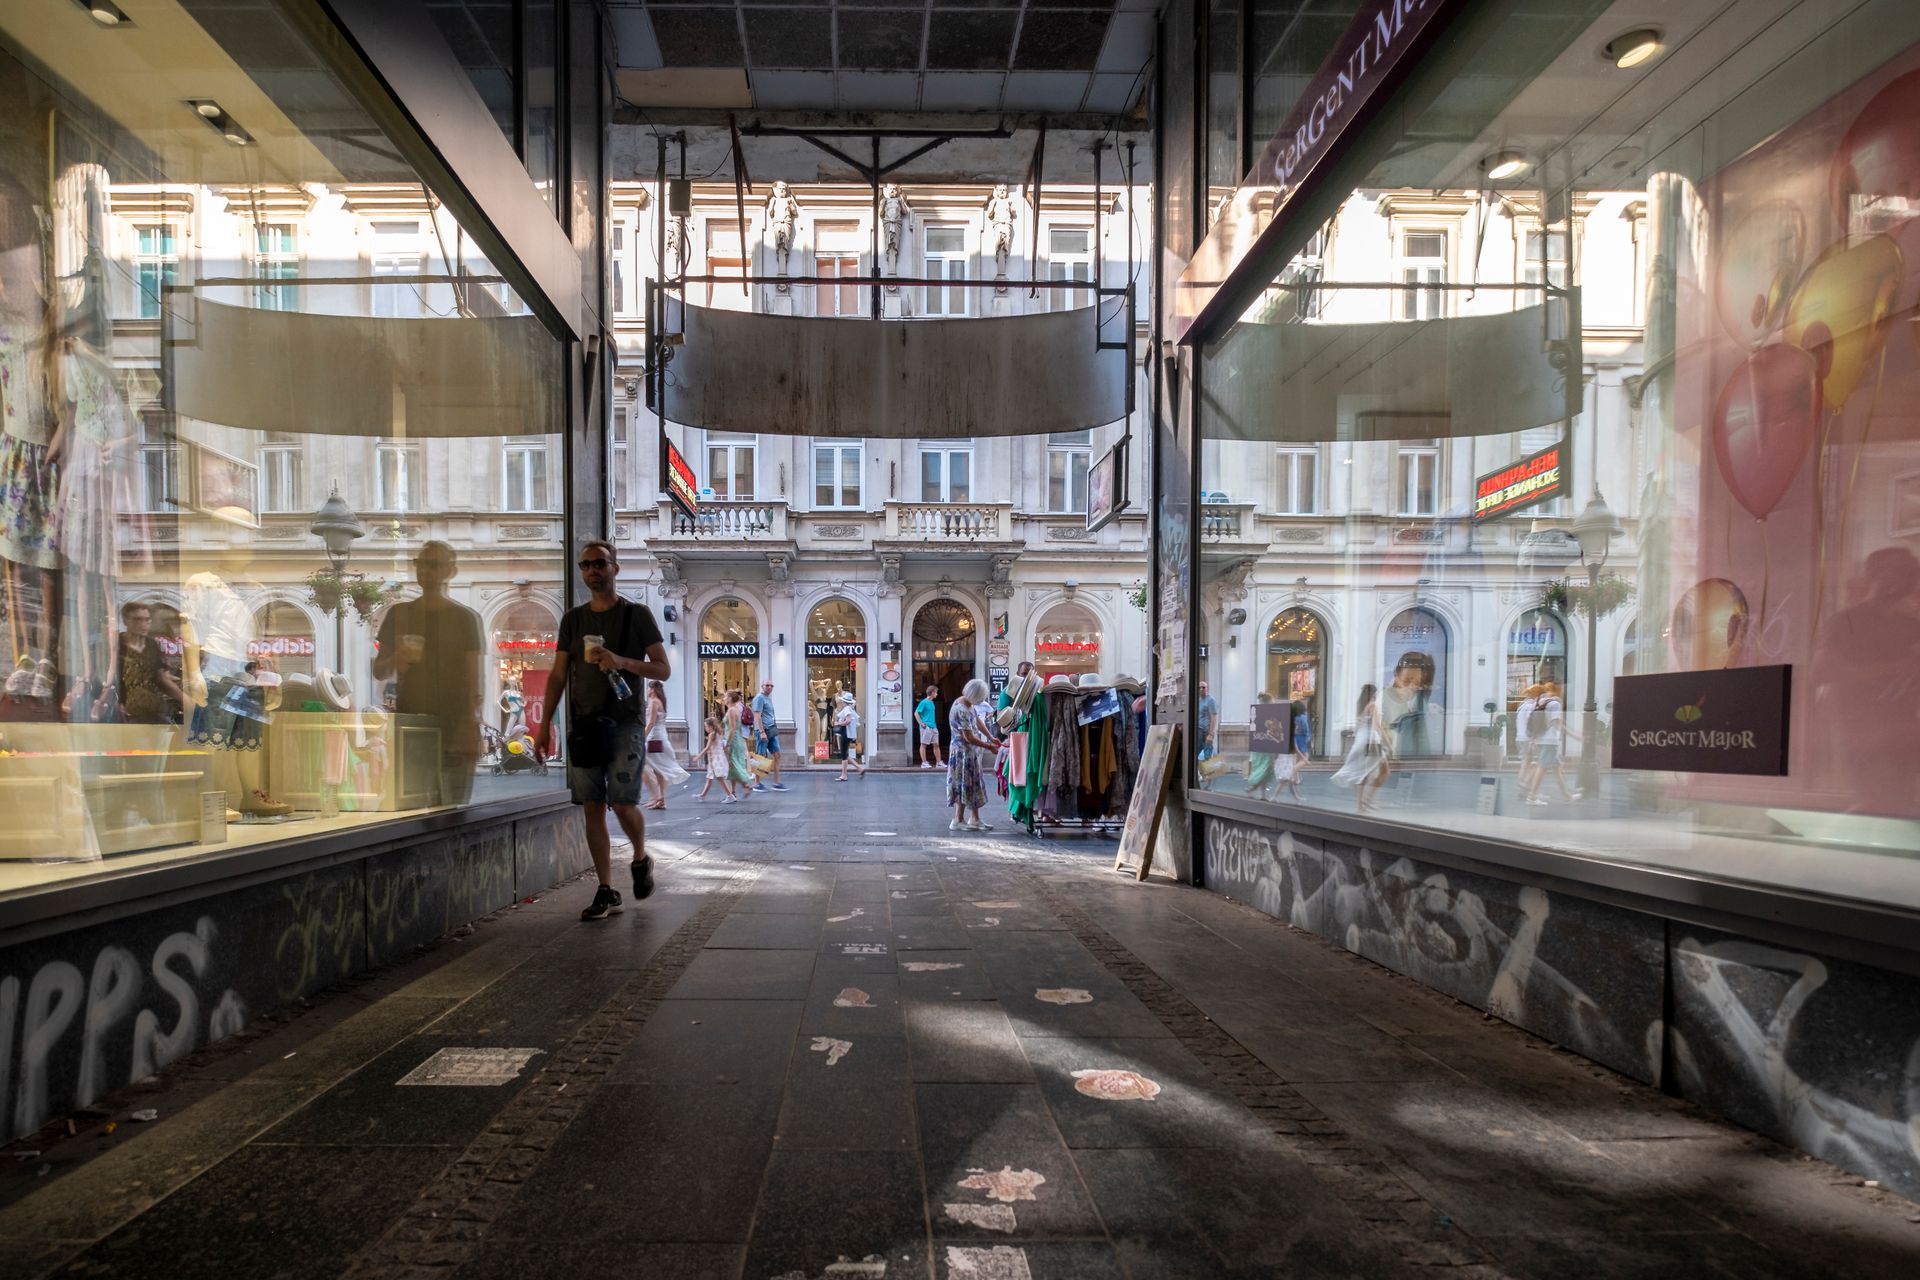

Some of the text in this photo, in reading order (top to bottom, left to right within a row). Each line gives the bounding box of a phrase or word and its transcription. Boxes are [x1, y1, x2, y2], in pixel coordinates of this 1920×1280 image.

[701, 644, 756, 655] INCANTO
[808, 645, 864, 655] INCANTO
[1037, 642, 1099, 653] yamamay
[989, 668, 1009, 676] TATTOO
